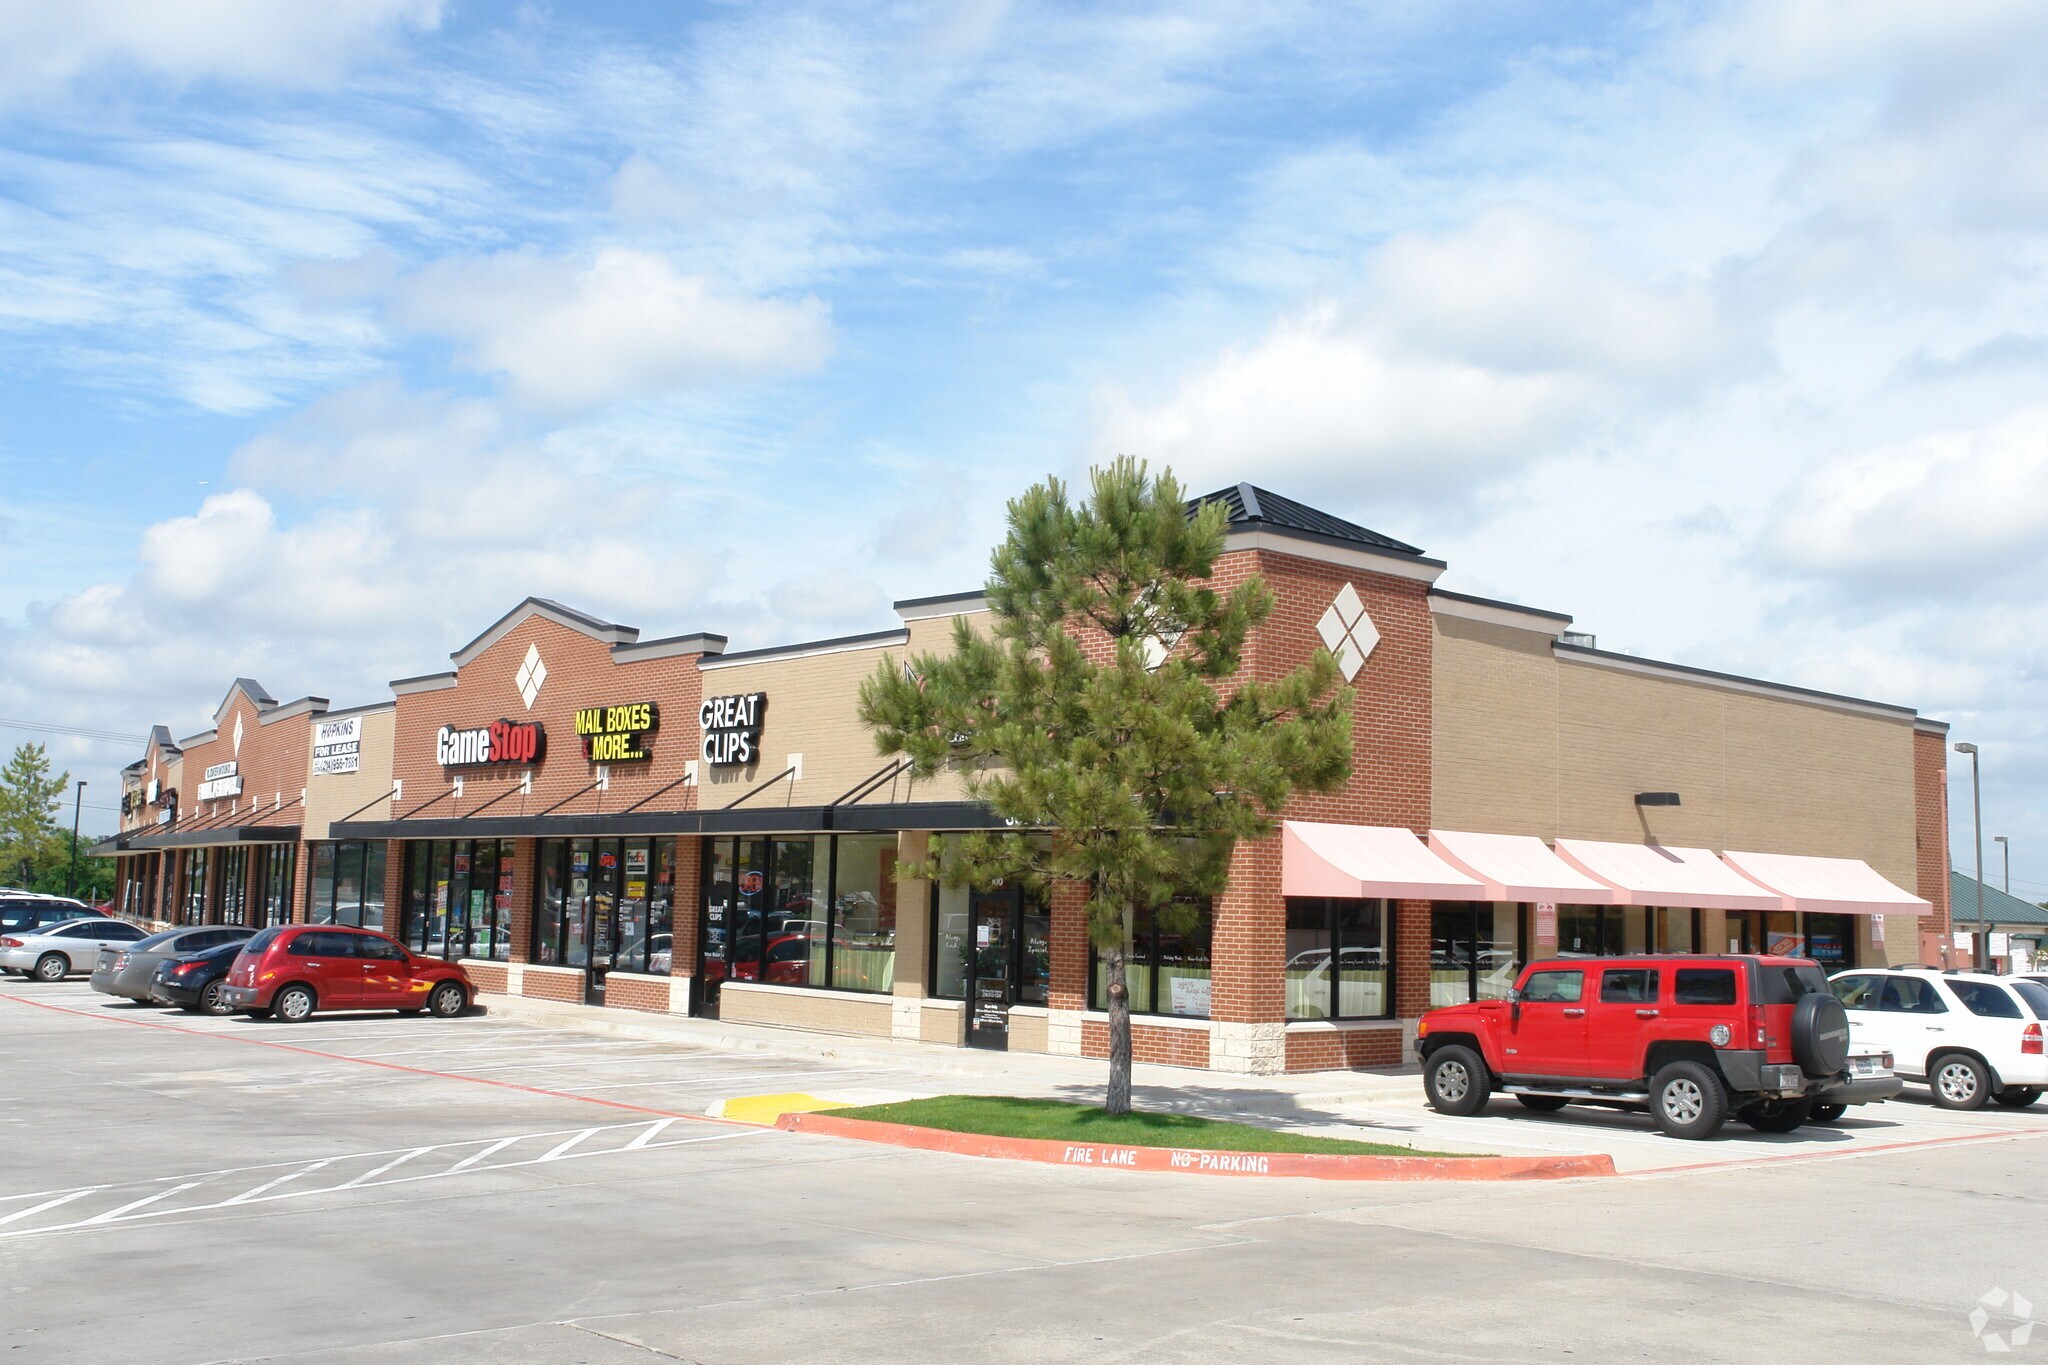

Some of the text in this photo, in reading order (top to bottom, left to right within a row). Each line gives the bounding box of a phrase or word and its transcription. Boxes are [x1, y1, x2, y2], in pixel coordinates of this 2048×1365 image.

[575, 703, 651, 735] MAIL BOXES
[699, 695, 758, 730] GREAT
[321, 720, 354, 739] HOPKINS
[315, 741, 358, 758] FOR LEASE
[436, 720, 537, 766] GameStop
[592, 733, 644, 761] MORE...
[702, 731, 751, 764] CLIPS
[627, 850, 646, 864] FedEx
[739, 874, 763, 892] OPEN
[708, 905, 723, 913] GREAT
[709, 913, 722, 921] CLIPS
[1063, 1146, 1094, 1163] FIRE
[1101, 1148, 1138, 1165] LANE
[1199, 1153, 1269, 1173] PARKING
